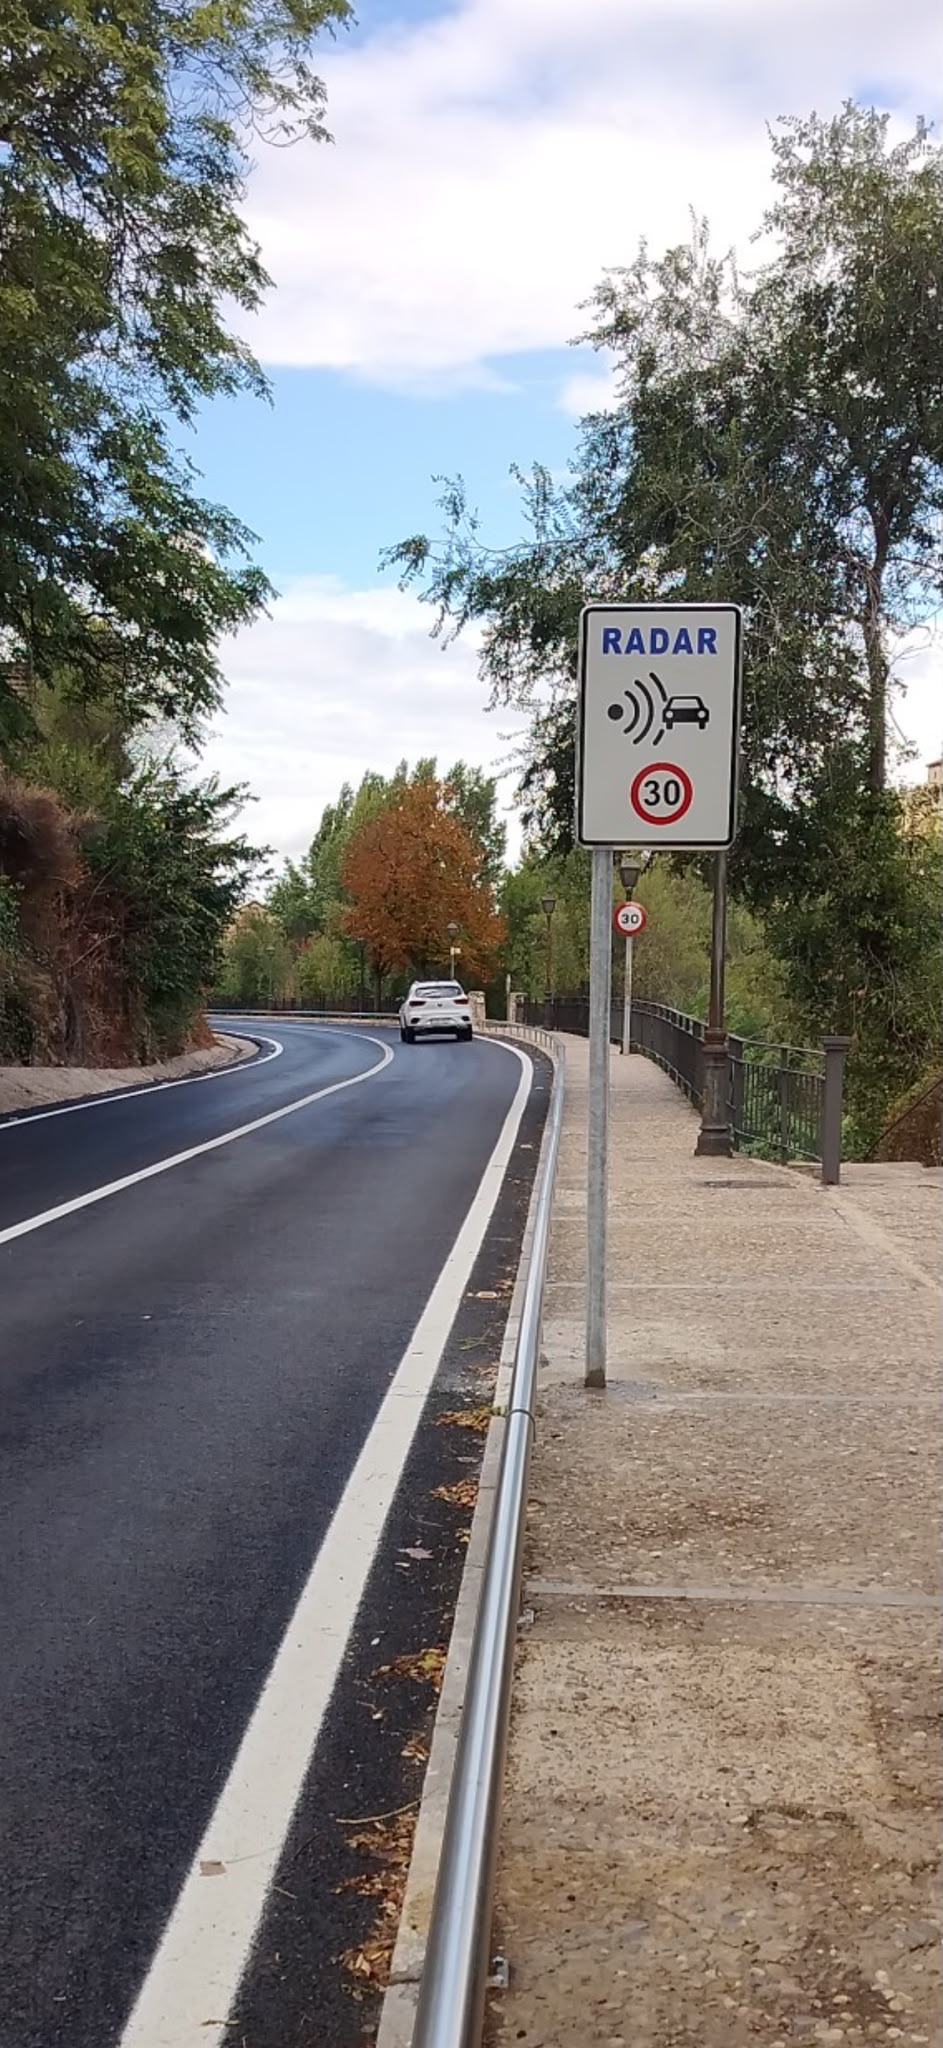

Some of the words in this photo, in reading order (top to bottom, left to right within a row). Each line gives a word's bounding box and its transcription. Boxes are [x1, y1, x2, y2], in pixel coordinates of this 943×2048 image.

[602, 627, 718, 655] RADAR
[643, 779, 681, 806] 30
[621, 913, 640, 924] 30
